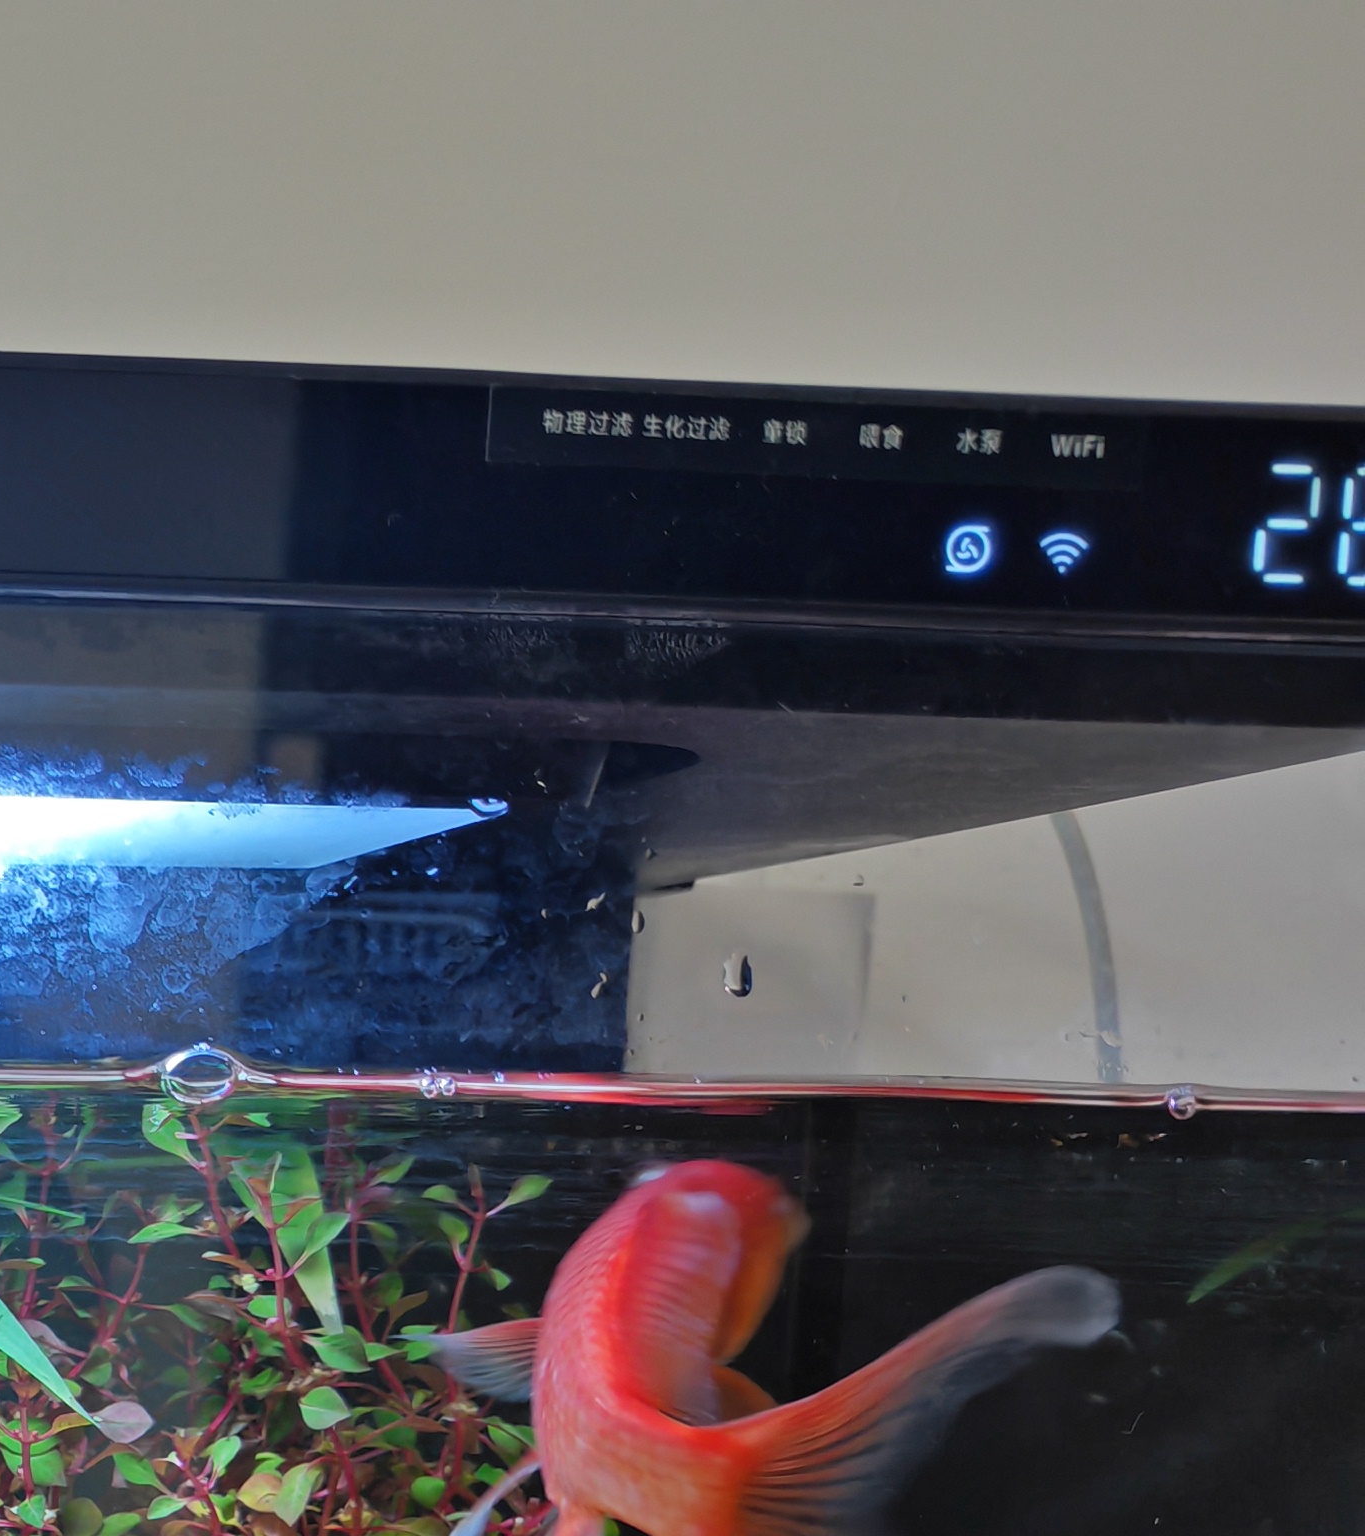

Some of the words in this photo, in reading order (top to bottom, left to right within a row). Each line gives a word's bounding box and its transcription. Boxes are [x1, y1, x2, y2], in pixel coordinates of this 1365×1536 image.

[542, 408, 633, 437] 物理过滤
[642, 412, 731, 441] 生化过滤
[956, 427, 1004, 455] 水泵
[1051, 434, 1106, 459] WiFi
